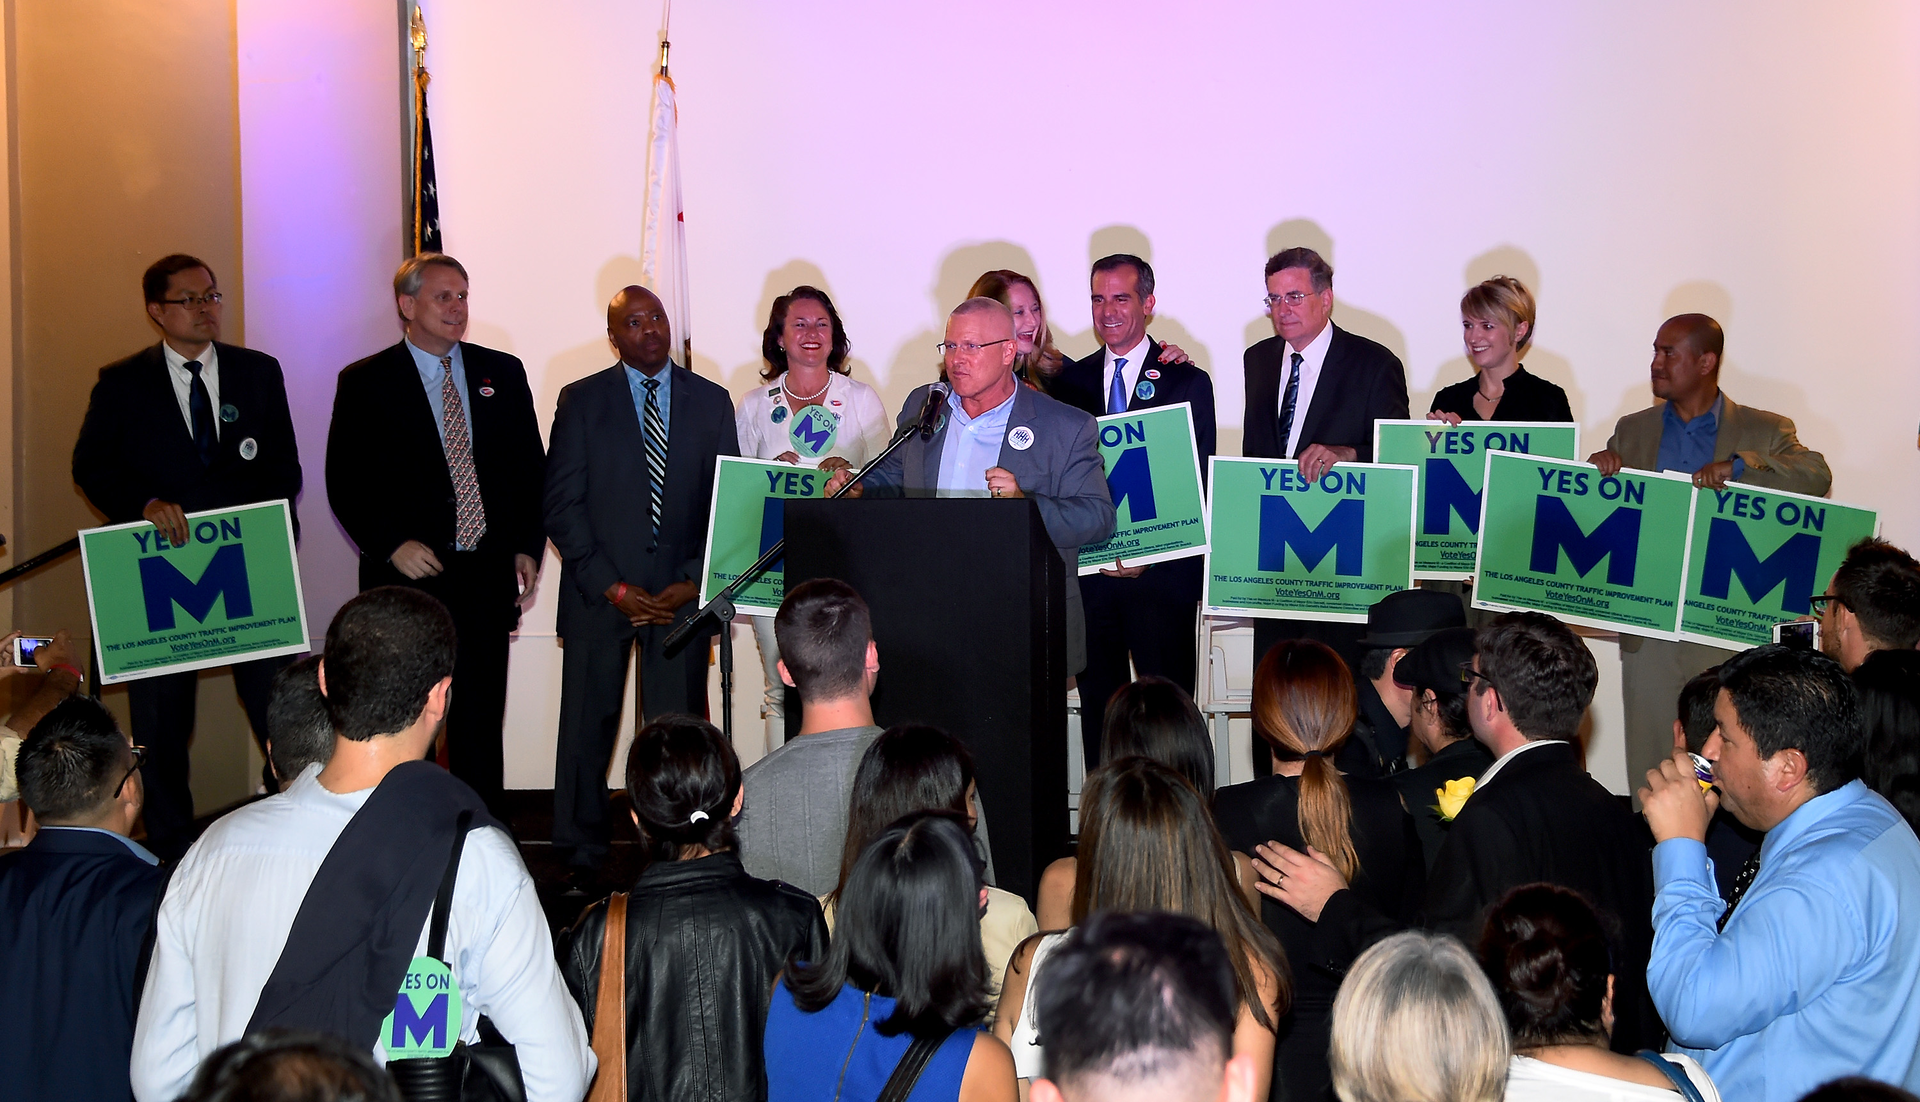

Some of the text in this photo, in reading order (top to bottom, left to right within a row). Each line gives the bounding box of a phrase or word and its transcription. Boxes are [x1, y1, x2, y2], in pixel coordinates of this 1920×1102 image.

[774, 409, 786, 421] M
[809, 406, 824, 421] YES
[822, 420, 836, 432] ON
[793, 414, 832, 454] M
[1100, 420, 1146, 448] ON
[1424, 431, 1529, 454] YES ON
[766, 470, 814, 496] YES
[1260, 468, 1366, 495] YES ON
[1538, 467, 1646, 505] YES ON
[1714, 490, 1826, 532] YES ON
[132, 517, 242, 554] YE ON
[1132, 520, 1180, 534] IMPROVEMENT
[1181, 518, 1199, 526] PLAN
[1258, 494, 1364, 576] M
[1415, 540, 1438, 548] NGELES
[1528, 494, 1642, 588] M
[1440, 550, 1476, 560] VoteYesO
[1700, 517, 1822, 615] M
[138, 543, 254, 632] M
[714, 572, 727, 580] THE
[1214, 574, 1228, 582] THE
[1243, 576, 1274, 584] ANGELES
[1275, 578, 1303, 586] COUNTY
[1305, 580, 1333, 588] TRAFFIC
[1335, 582, 1384, 591] IMPROVEMENT
[1385, 584, 1404, 592] PLAN
[1484, 570, 1498, 578] THE
[1514, 576, 1544, 586] ANGELES
[1546, 580, 1574, 590] COUNTY
[1576, 584, 1604, 596] TRAFFIC
[1605, 590, 1654, 604] IMPROVEMENT
[1654, 598, 1673, 608] PLAN
[1275, 588, 1340, 600] VoteYesOnM.org
[1545, 590, 1610, 609] VoteYesOnM.org
[1684, 600, 1778, 622] ANGELES COUNTY TRAFFIC
[106, 616, 296, 652] THE LOS ANGELES COUNTY TRAFFIC IMPROVEMENT PLAN
[1716, 615, 1771, 634] VoteYesOnM.
[170, 636, 236, 654] VoteYesOnM.org
[406, 974, 450, 990] ES ON
[391, 992, 449, 1048] M
